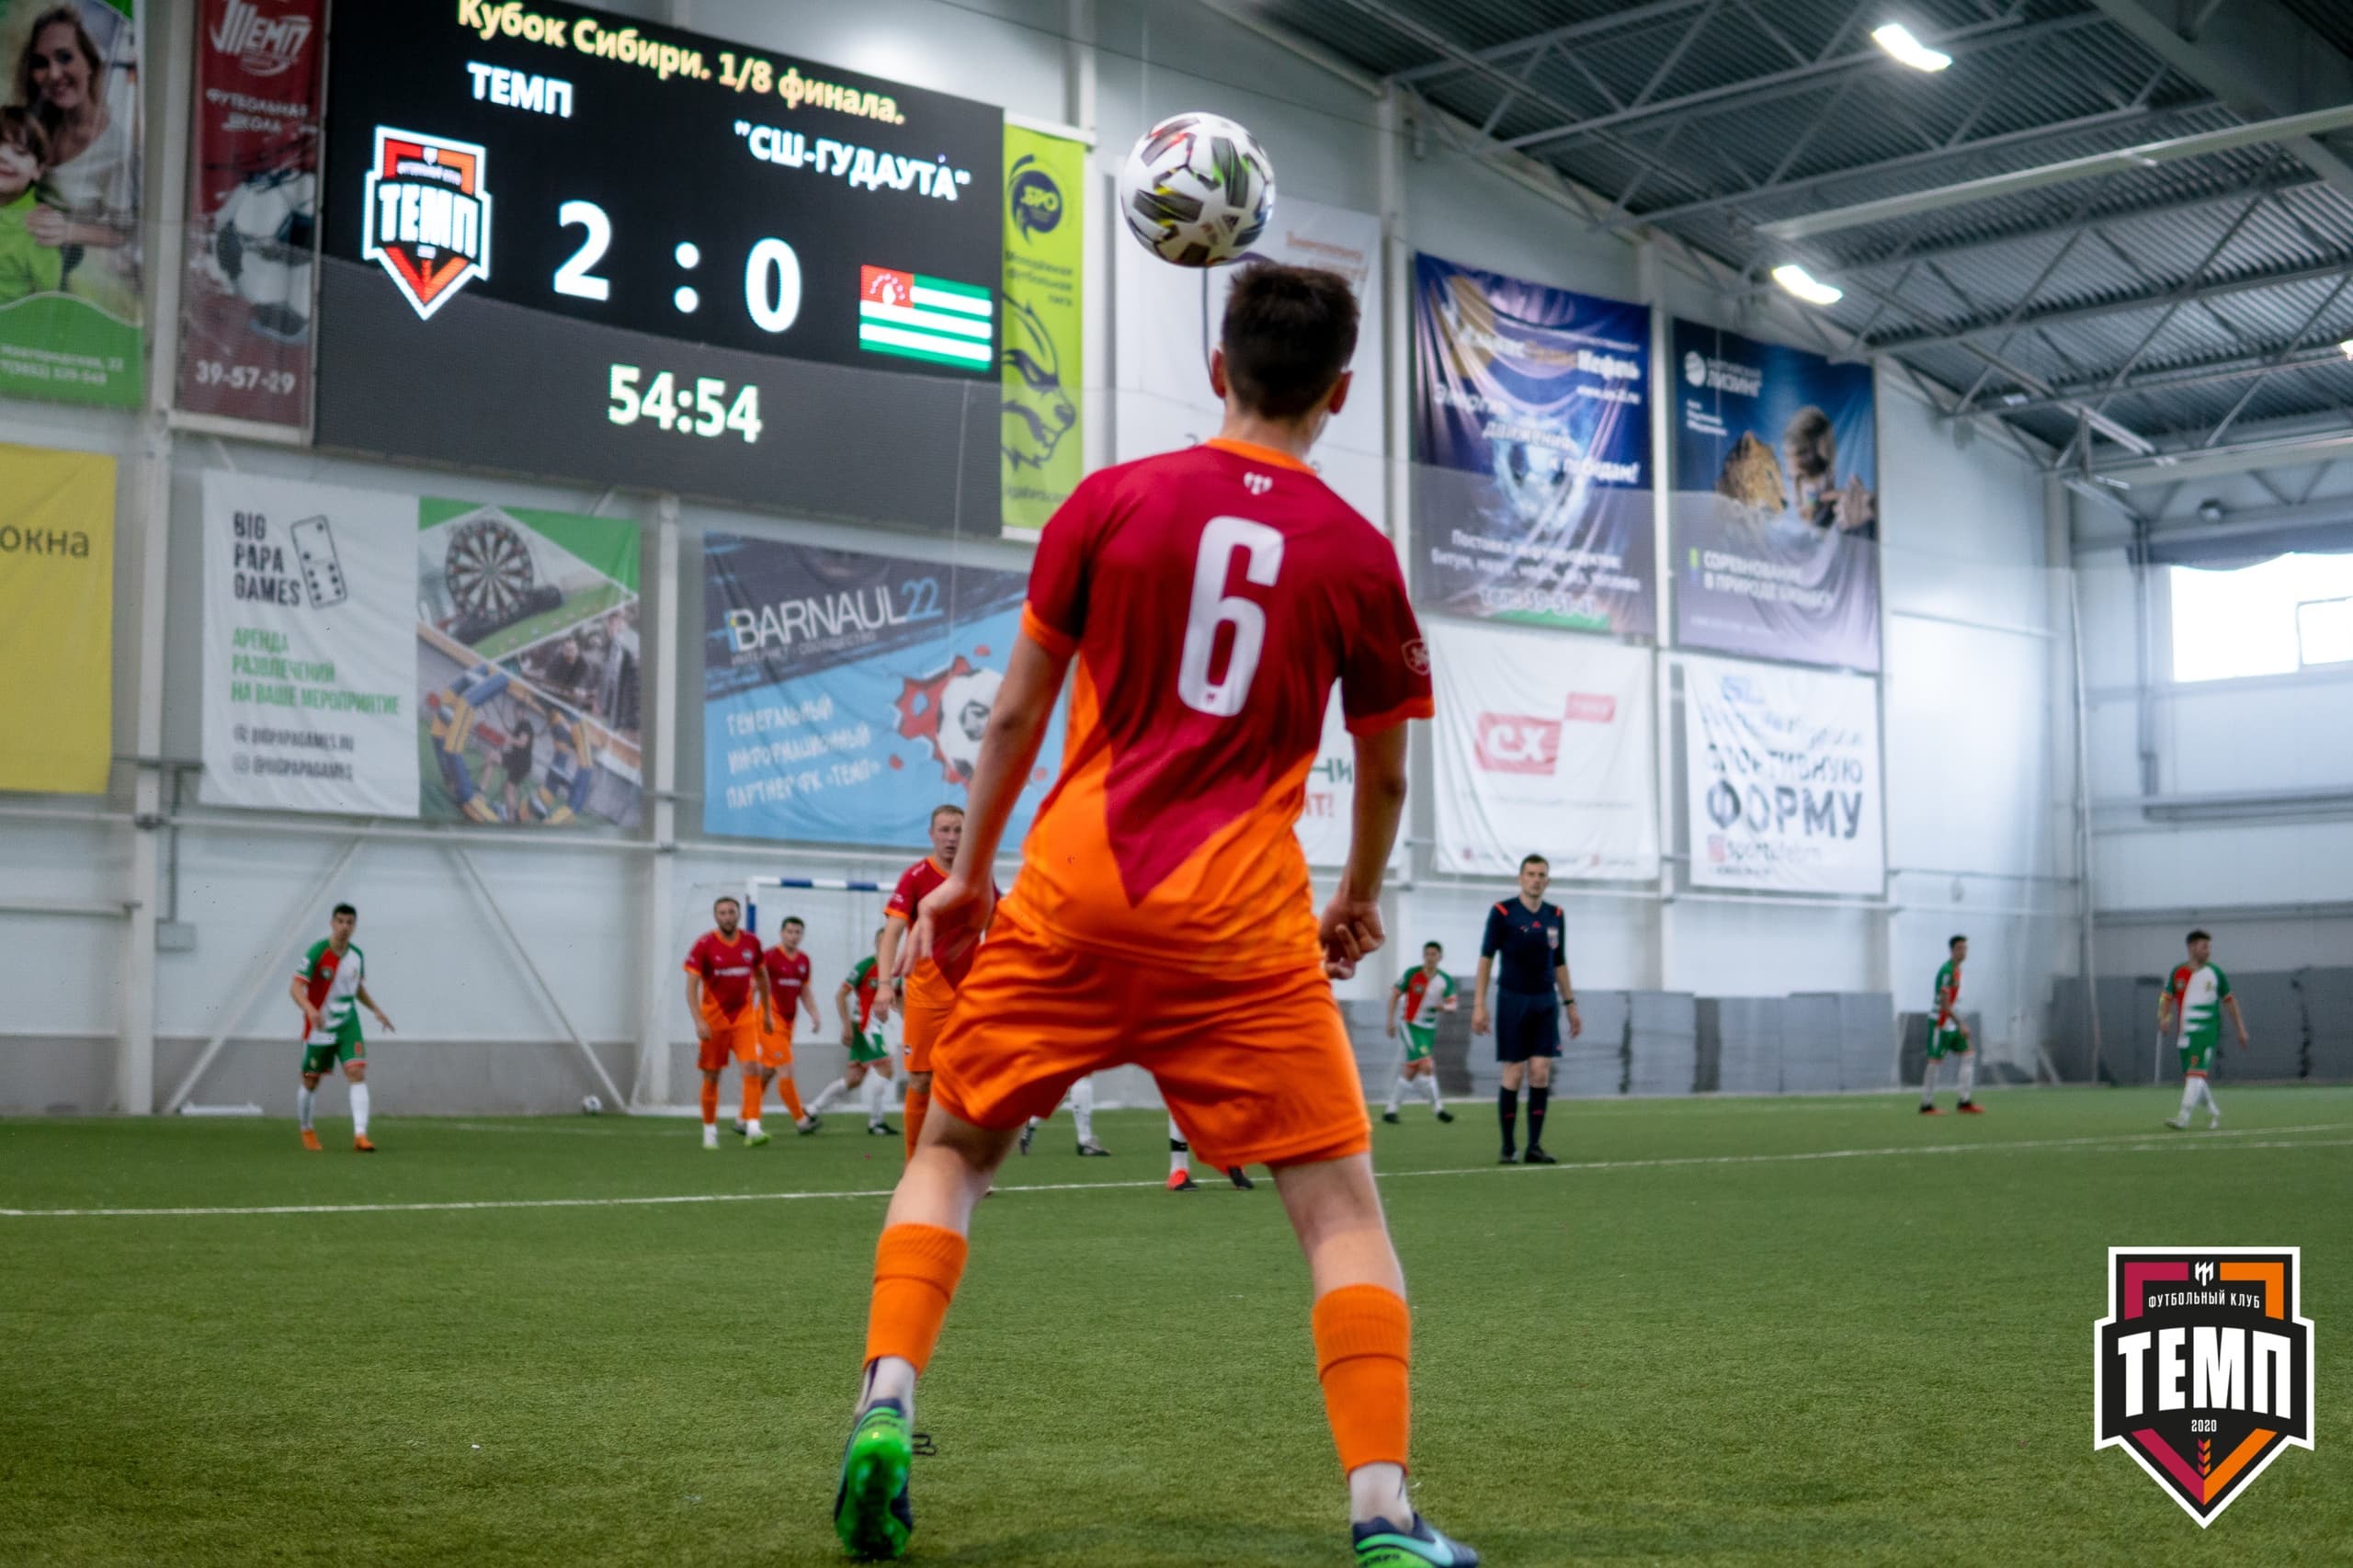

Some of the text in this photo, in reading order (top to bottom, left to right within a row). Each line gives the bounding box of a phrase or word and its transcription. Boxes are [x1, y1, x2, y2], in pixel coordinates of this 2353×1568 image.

[458, 0, 905, 125] Кубок Сибири. 1/8 финала.
[466, 61, 574, 119] ТЕМП
[378, 182, 479, 259] ТЕМП
[553, 199, 611, 301] 2
[745, 237, 801, 333] 0
[608, 362, 763, 443] 54:54
[233, 511, 267, 540] BIG
[233, 542, 284, 574] PAPA
[234, 574, 301, 607] GAMES
[1177, 515, 1285, 718] 6
[1707, 778, 1863, 840] ФОРМУ
